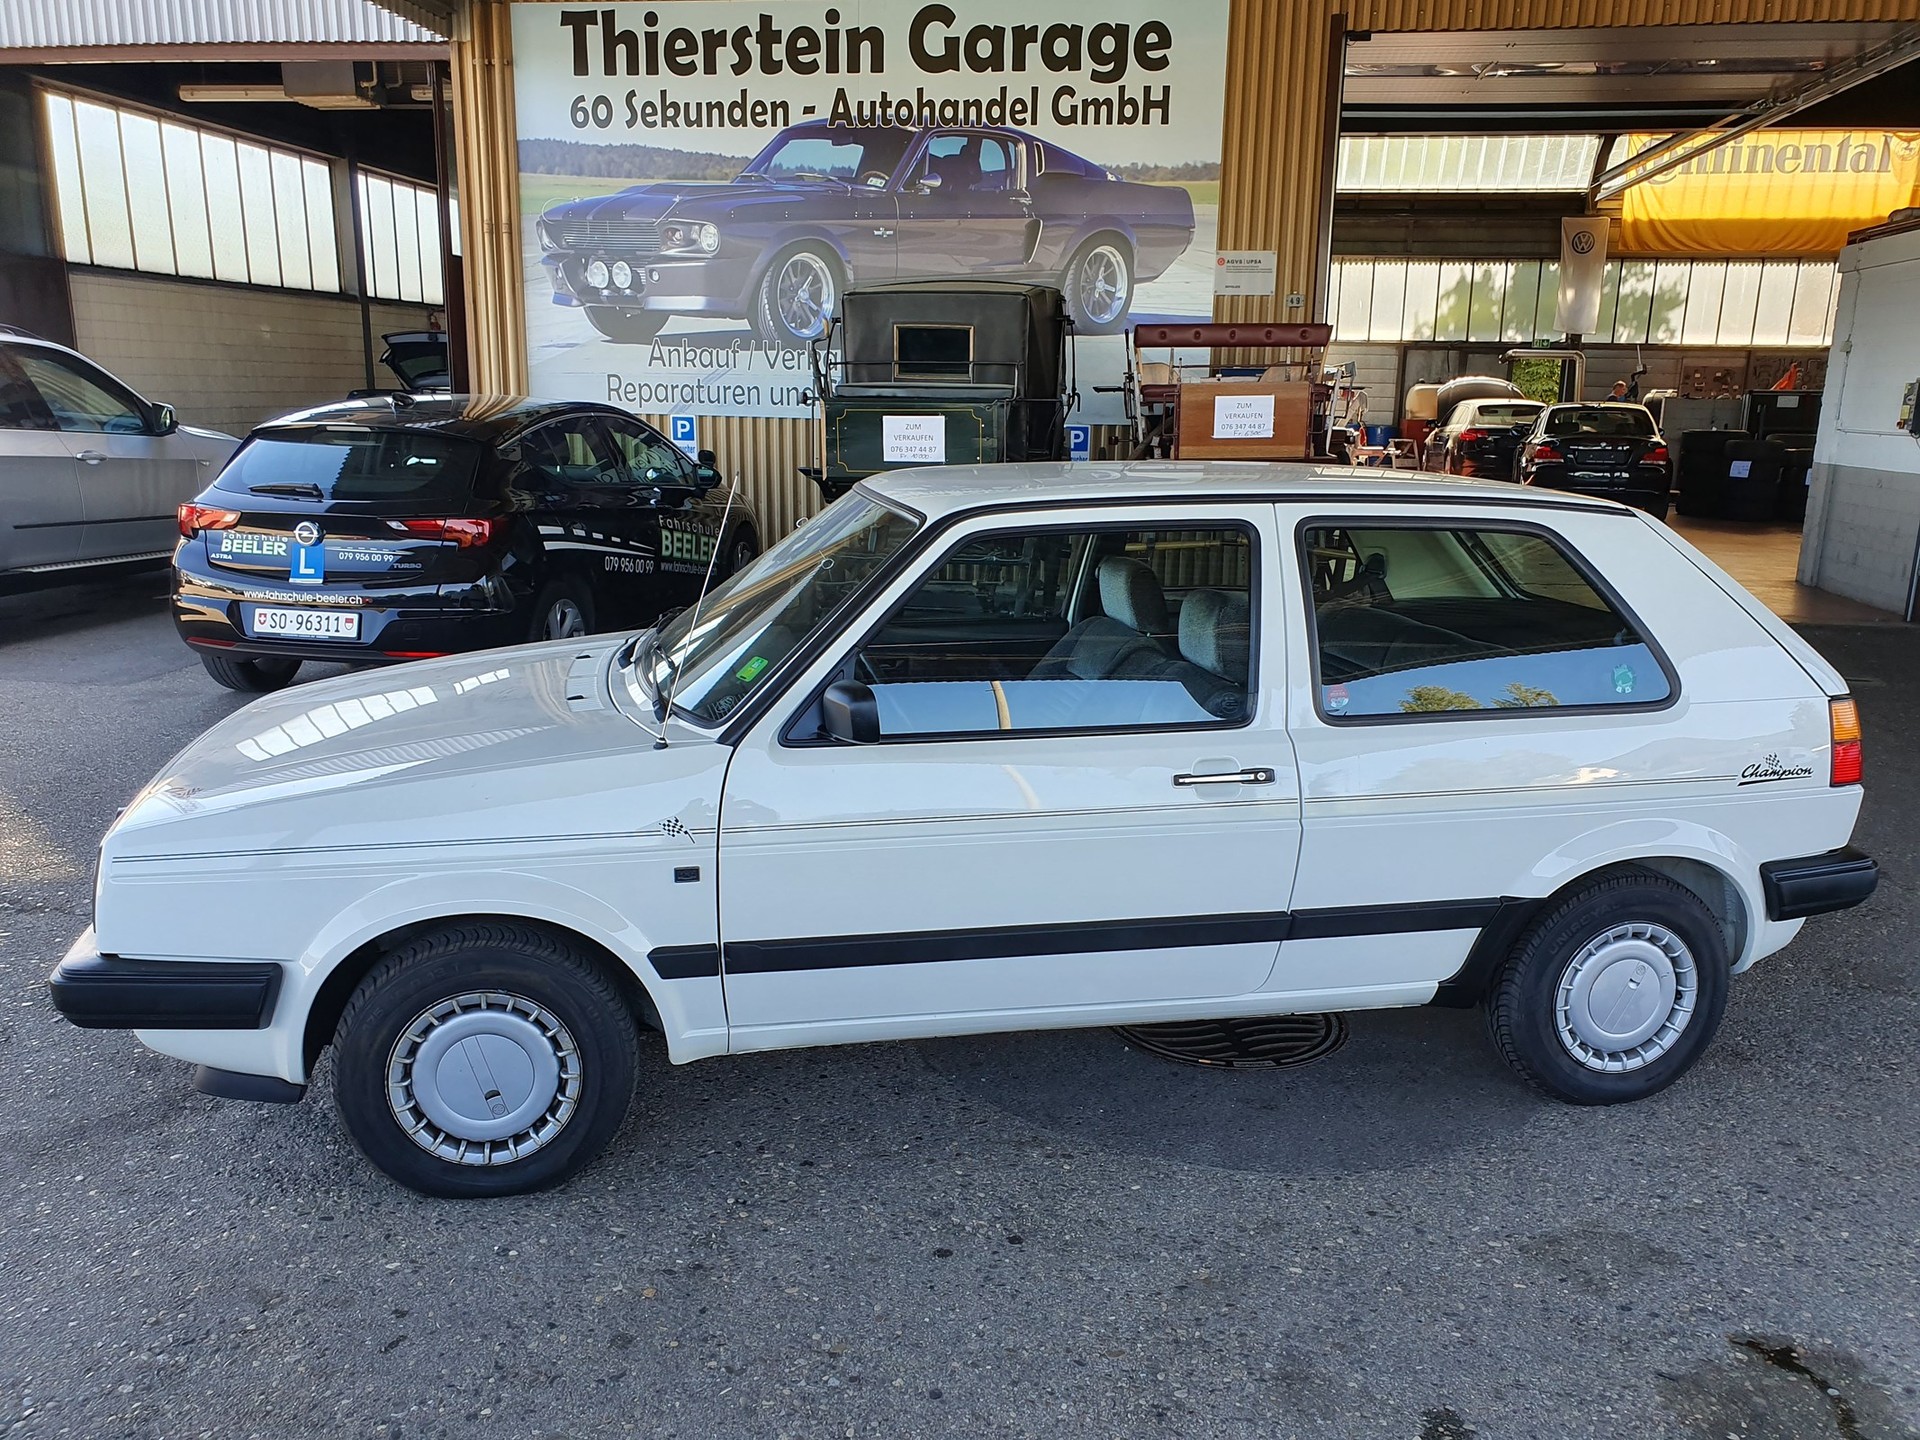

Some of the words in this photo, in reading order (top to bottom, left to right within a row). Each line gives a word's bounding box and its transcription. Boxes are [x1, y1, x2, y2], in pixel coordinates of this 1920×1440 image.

[560, 8, 885, 77] Thierstein
[908, 3, 1172, 84] Garage
[570, 94, 613, 129] 60
[625, 88, 790, 129] Sekunden
[802, 104, 816, 116] -
[827, 86, 1039, 128] Autohandel
[1051, 84, 1171, 126] GmbH
[648, 337, 741, 370] Ankauf
[747, 339, 756, 371] /
[606, 373, 761, 408] Reparaturen
[677, 420, 690, 439] P
[1071, 430, 1084, 449] P
[658, 514, 721, 537] Fahrschule
[223, 532, 288, 543] Fahrschule
[221, 539, 287, 556] BEELER
[339, 552, 353, 560] 079
[355, 553, 369, 561] 956
[371, 554, 382, 562] 00
[299, 548, 315, 575] L
[604, 556, 619, 571] 079
[620, 556, 634, 573] 956
[635, 559, 645, 573] 00
[645, 560, 655, 574] 99
[243, 589, 363, 605] www.fahrschule-beeler.ch
[1741, 763, 1814, 780] Champion
